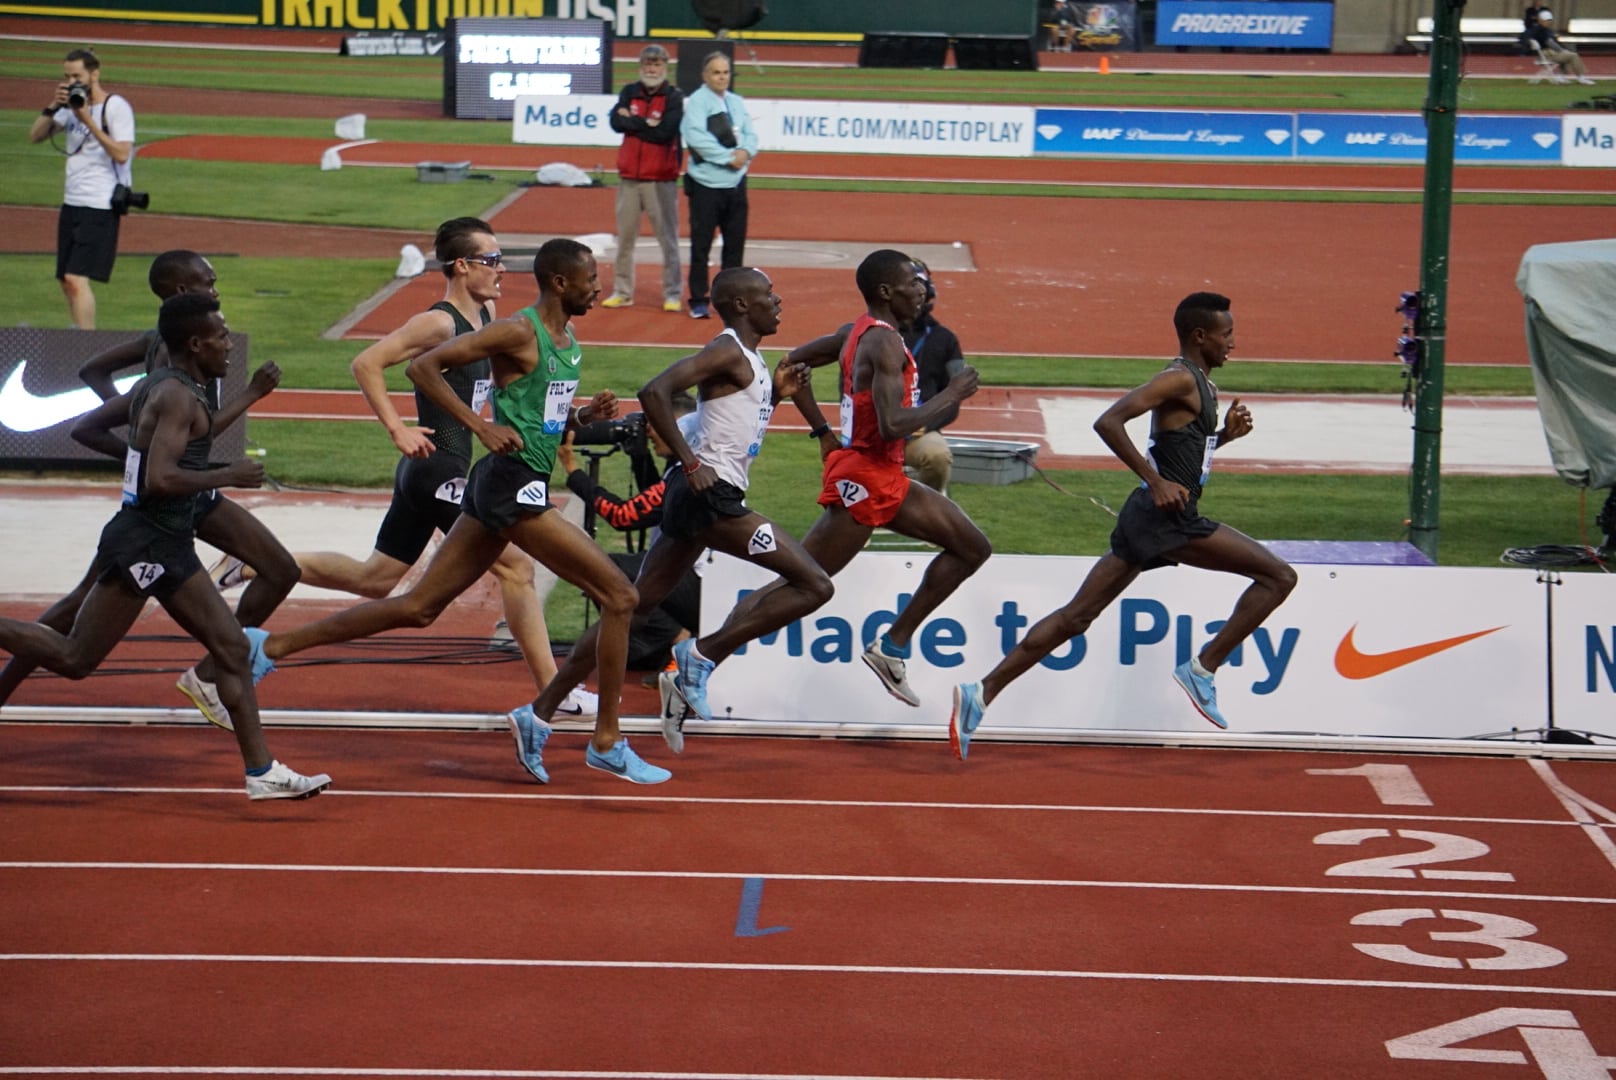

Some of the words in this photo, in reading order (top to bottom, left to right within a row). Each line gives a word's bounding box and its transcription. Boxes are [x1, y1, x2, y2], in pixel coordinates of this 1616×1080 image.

[1171, 13, 1312, 35] PROGRESSIVE
[525, 105, 598, 129] Made
[782, 115, 1023, 143] NIKE.COM/MADETOPLAY
[1082, 128, 1123, 140] IAAF
[1345, 132, 1386, 145] IAAF
[445, 482, 461, 501] 2
[522, 486, 544, 502] 10
[842, 481, 859, 502] 12
[752, 529, 772, 550] 15
[139, 564, 156, 582] 14
[1304, 763, 1434, 806] 1
[1312, 828, 1516, 882] 2
[1349, 908, 1568, 970] 3
[1383, 1006, 1616, 1080] 4
